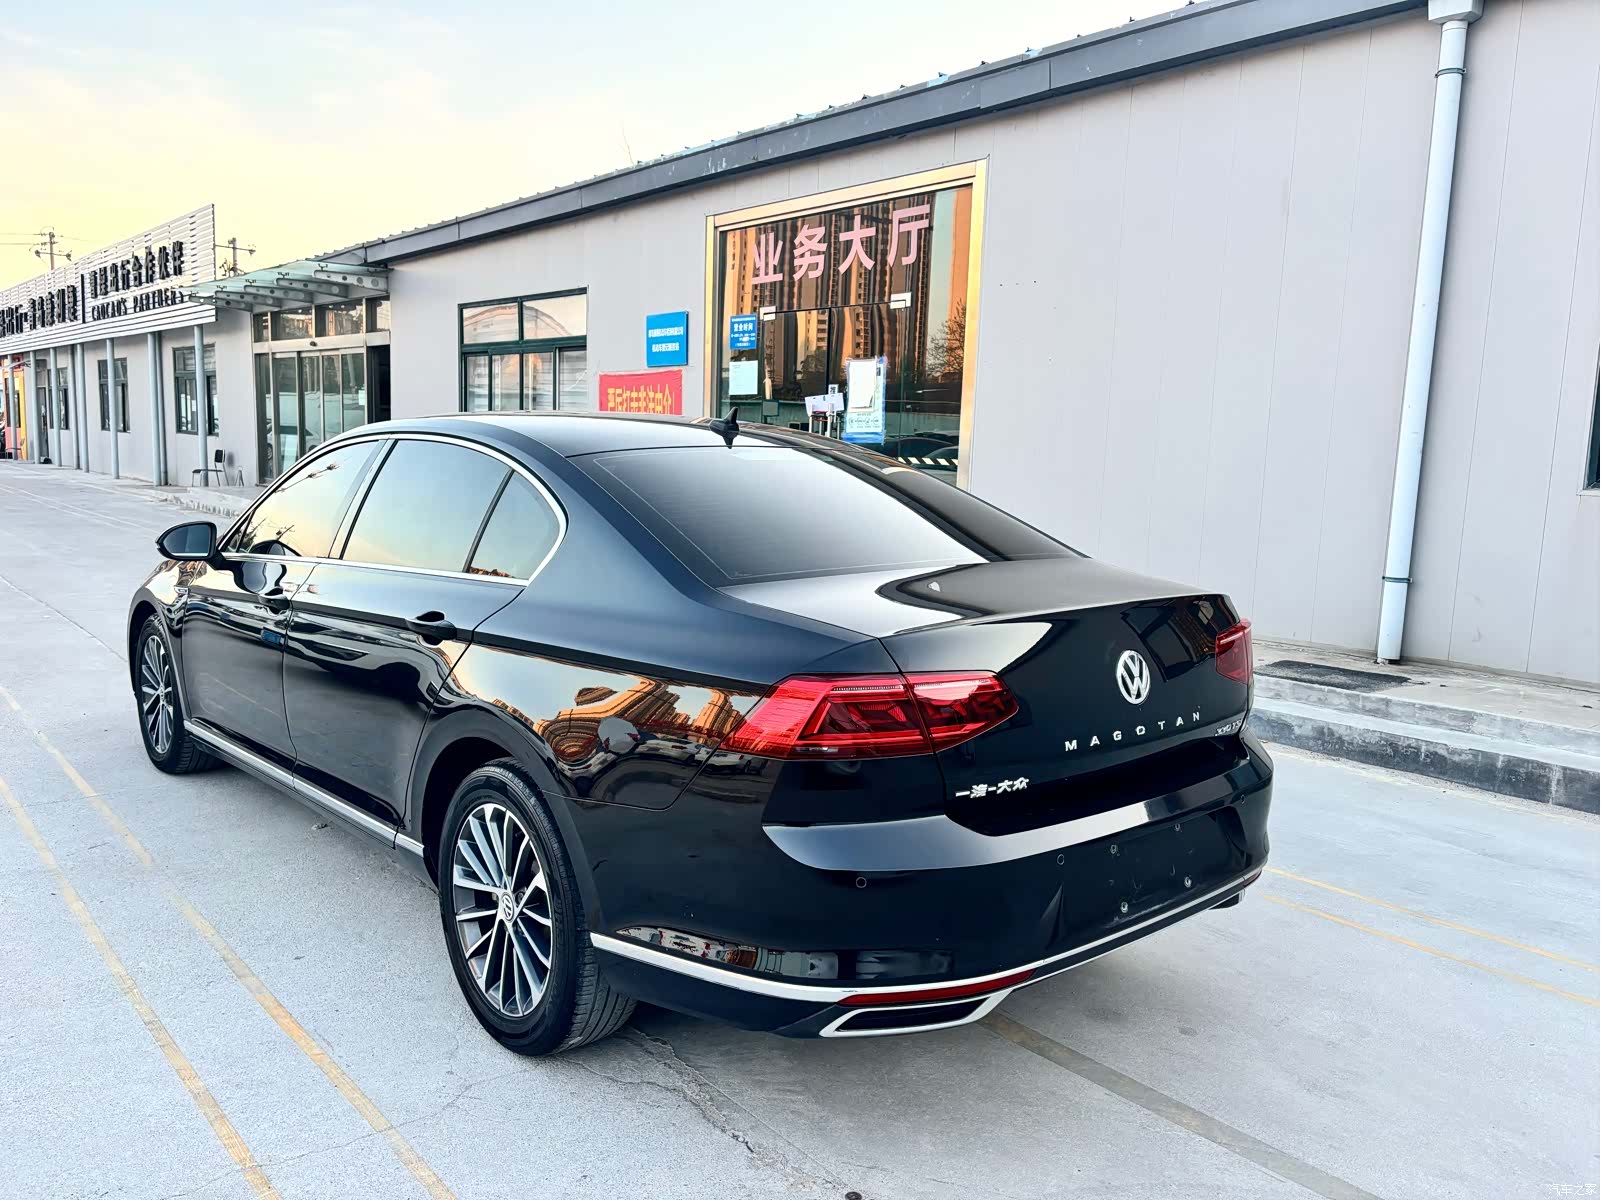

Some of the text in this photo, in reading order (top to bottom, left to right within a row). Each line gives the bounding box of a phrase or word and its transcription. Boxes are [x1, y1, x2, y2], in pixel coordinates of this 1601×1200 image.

[752, 204, 931, 284] 业务大厅
[1064, 711, 1200, 752] MAGOTAN
[955, 776, 1030, 799] 一汽-大众
